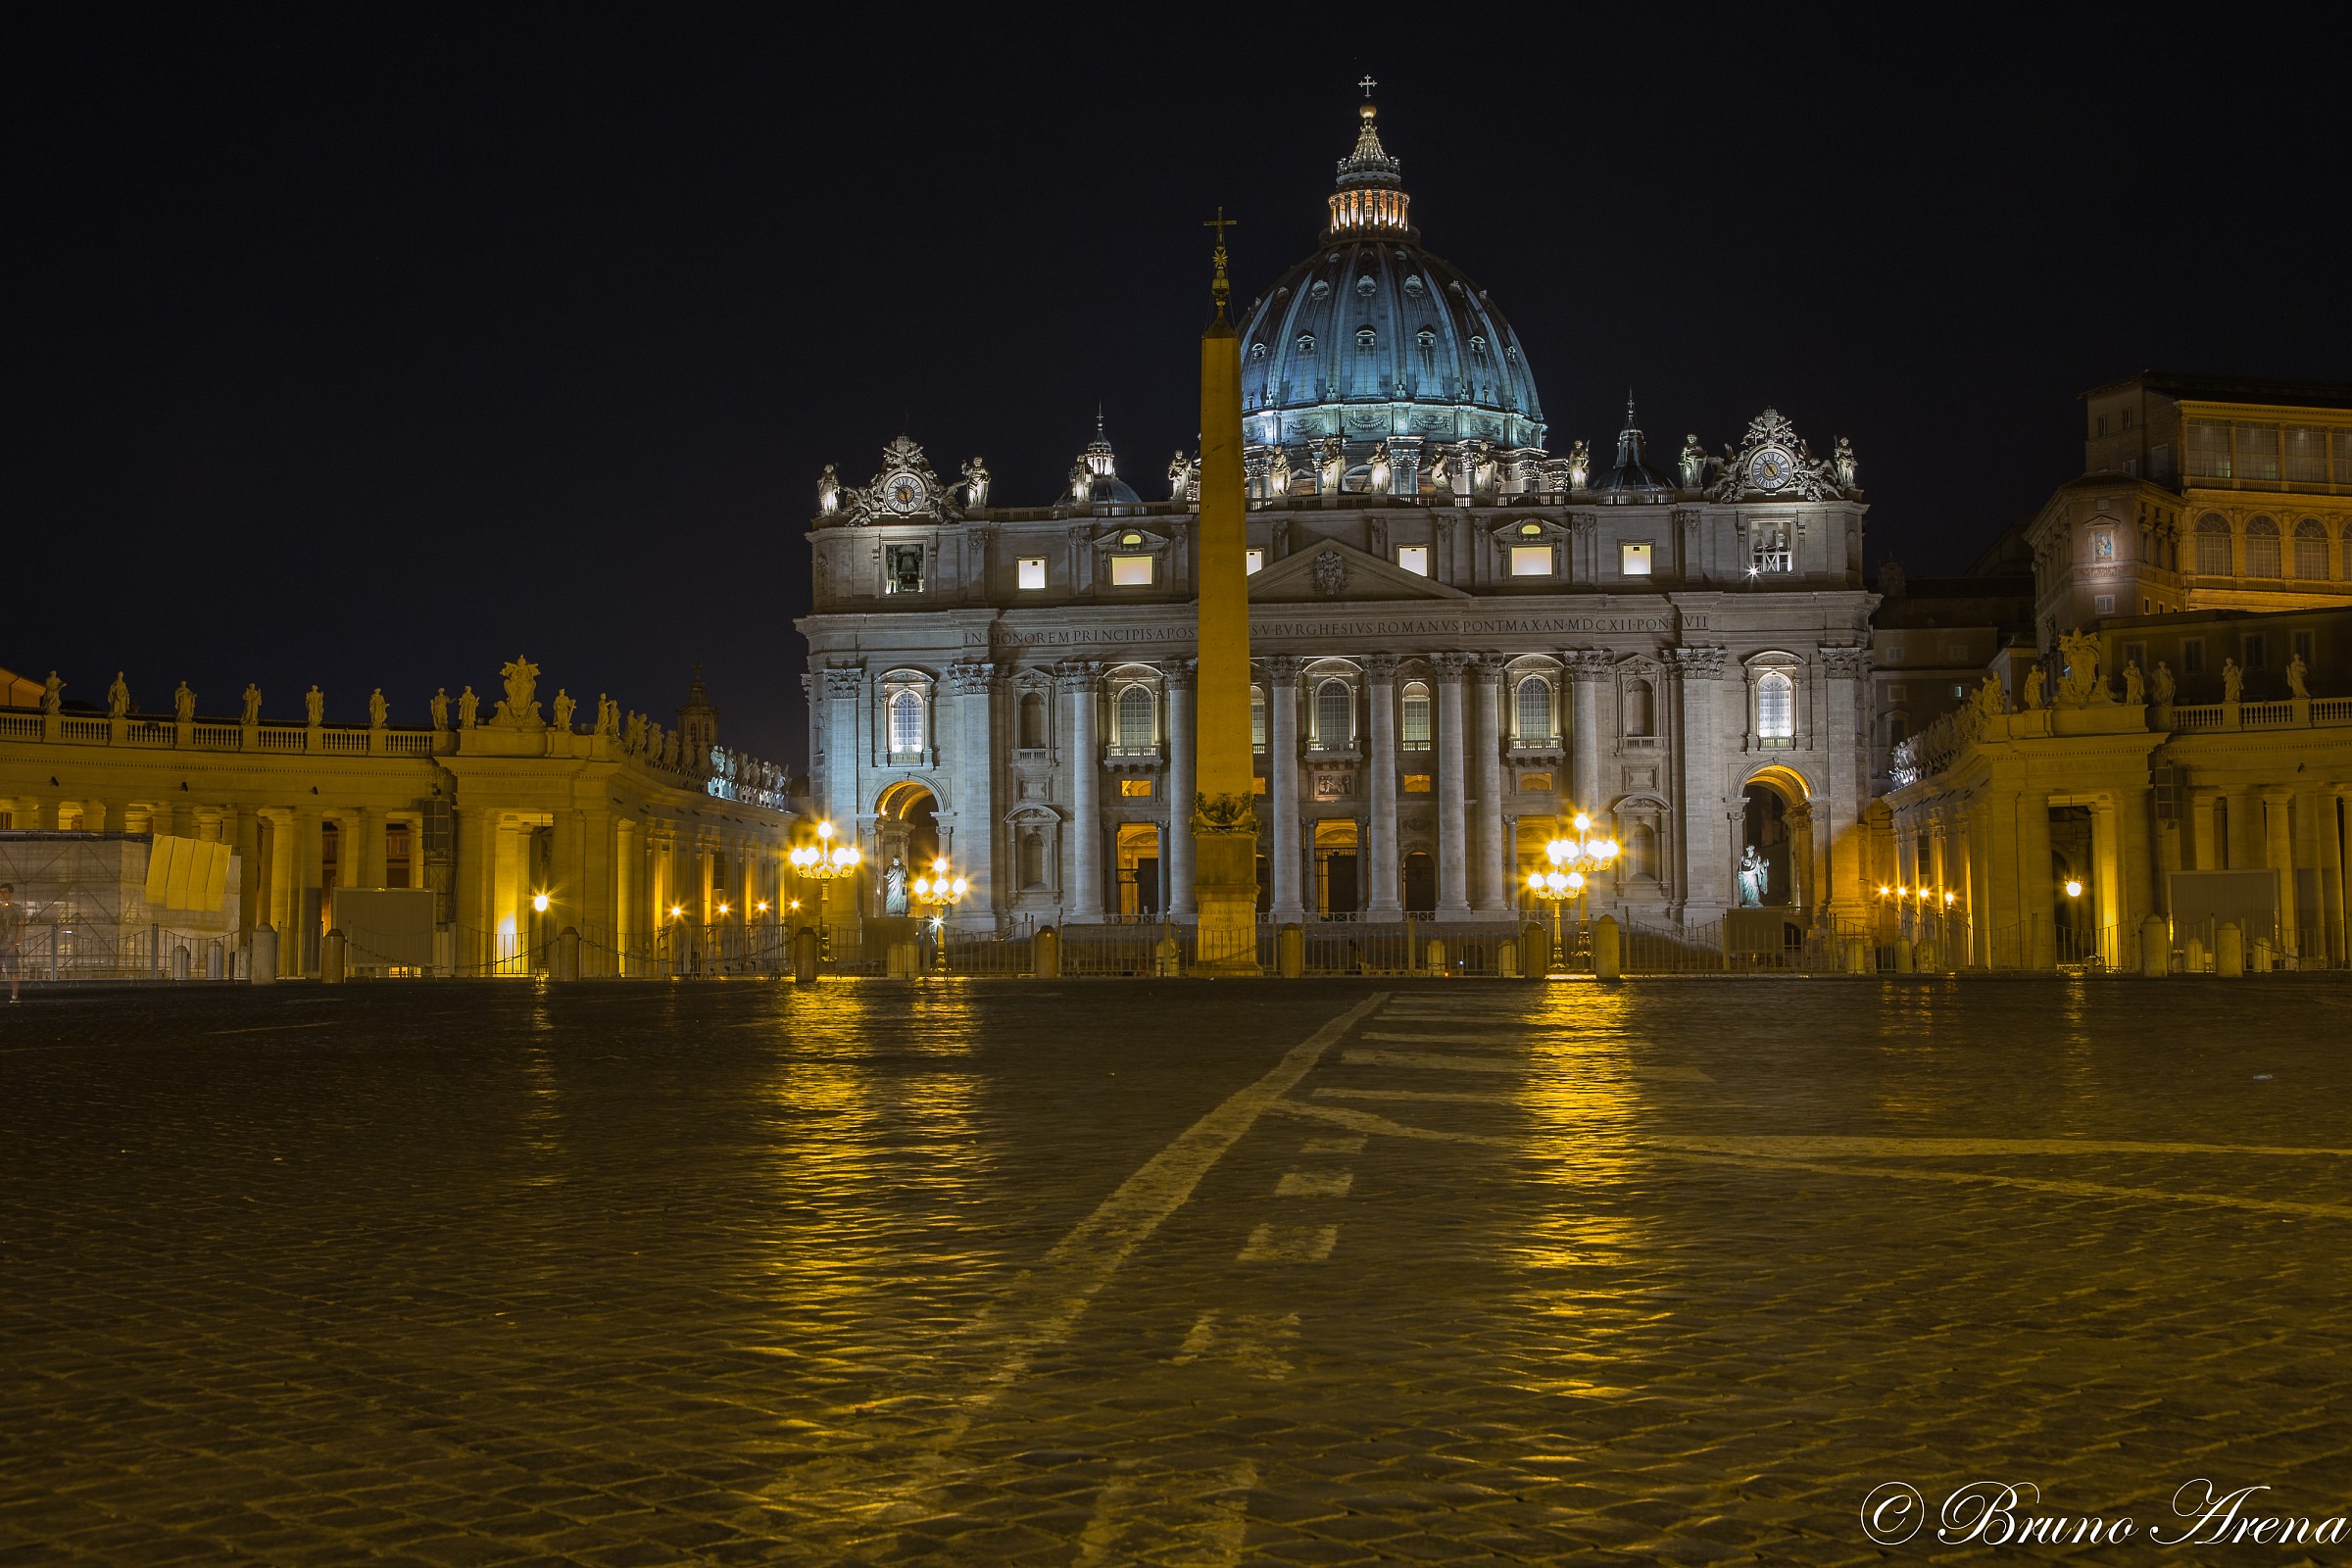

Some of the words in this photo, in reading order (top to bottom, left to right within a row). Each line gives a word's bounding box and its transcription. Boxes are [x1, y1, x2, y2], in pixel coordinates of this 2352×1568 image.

[963, 632, 982, 644] IN
[990, 631, 1070, 644] HONOREM
[1074, 628, 1152, 643] PRINCIPIS
[1155, 626, 1199, 641] APOS
[1275, 622, 1373, 636] BVRGHESIVS
[1378, 620, 1458, 634] ROMANVS
[1463, 619, 1504, 632] PONT
[1505, 619, 1540, 632] MAX
[1543, 618, 1564, 631] AN
[1568, 618, 1633, 631] MDCXII
[1637, 617, 1679, 631] PONT
[1685, 615, 1708, 628] VII
